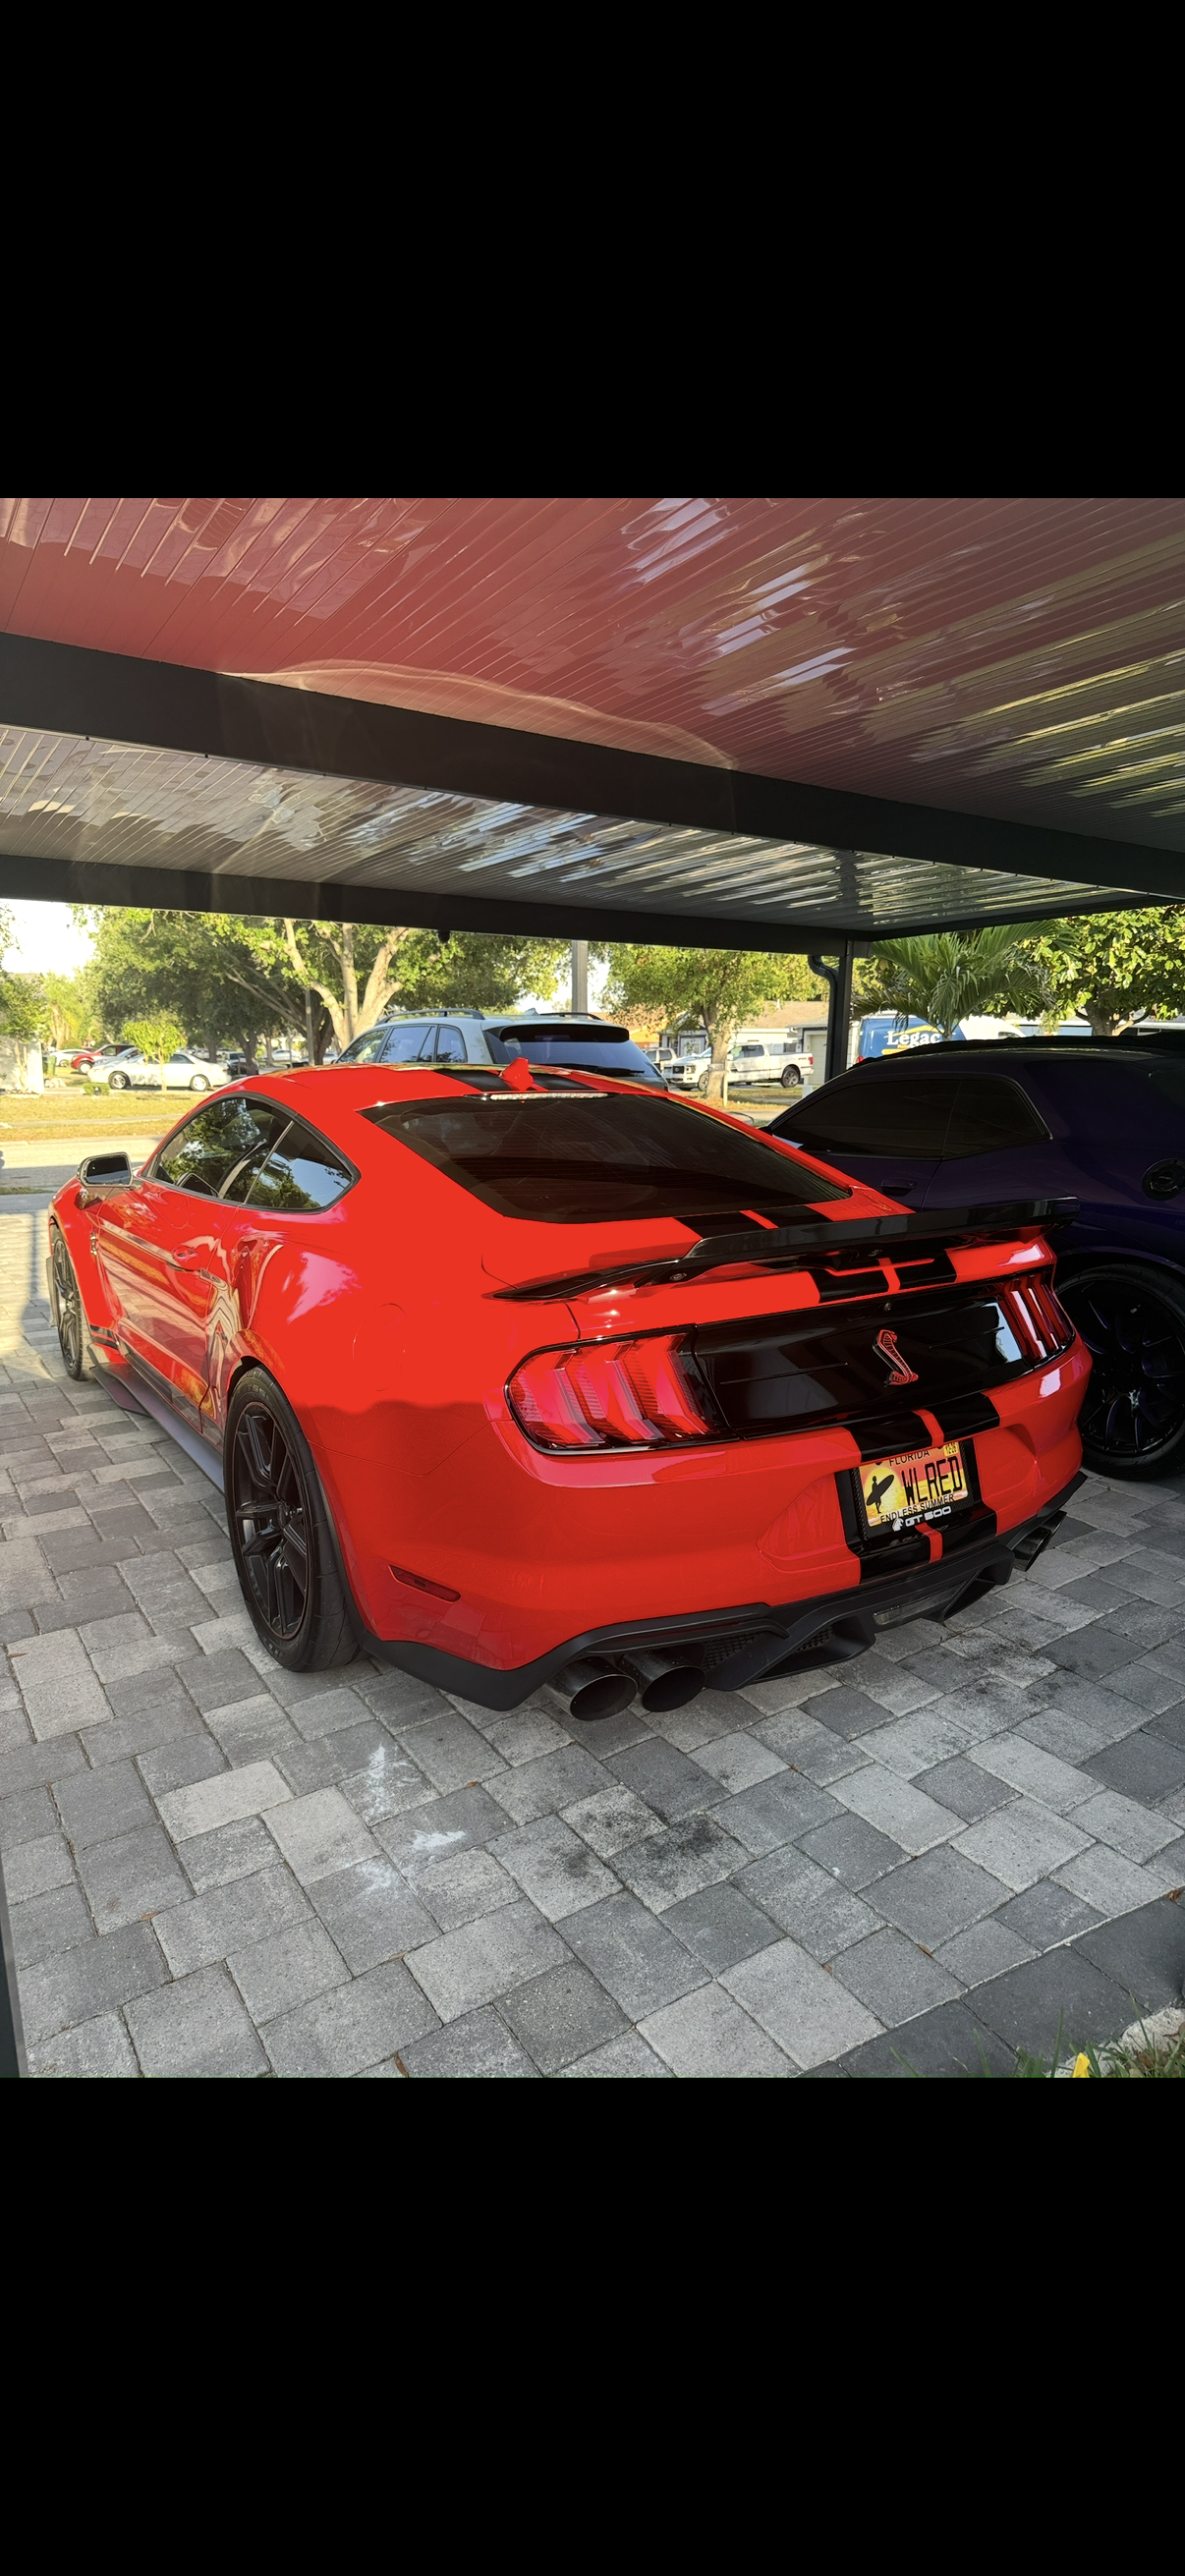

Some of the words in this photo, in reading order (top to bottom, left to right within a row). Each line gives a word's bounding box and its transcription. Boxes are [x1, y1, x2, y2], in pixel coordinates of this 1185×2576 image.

[886, 1030, 941, 1048] Legac
[888, 1450, 930, 1466] FLORIDA
[901, 1456, 963, 1506] WLRED
[879, 1504, 918, 1523] ENDLESS
[920, 1493, 955, 1510] SUMMER
[905, 1514, 923, 1527] GT
[925, 1506, 951, 1521] 500
